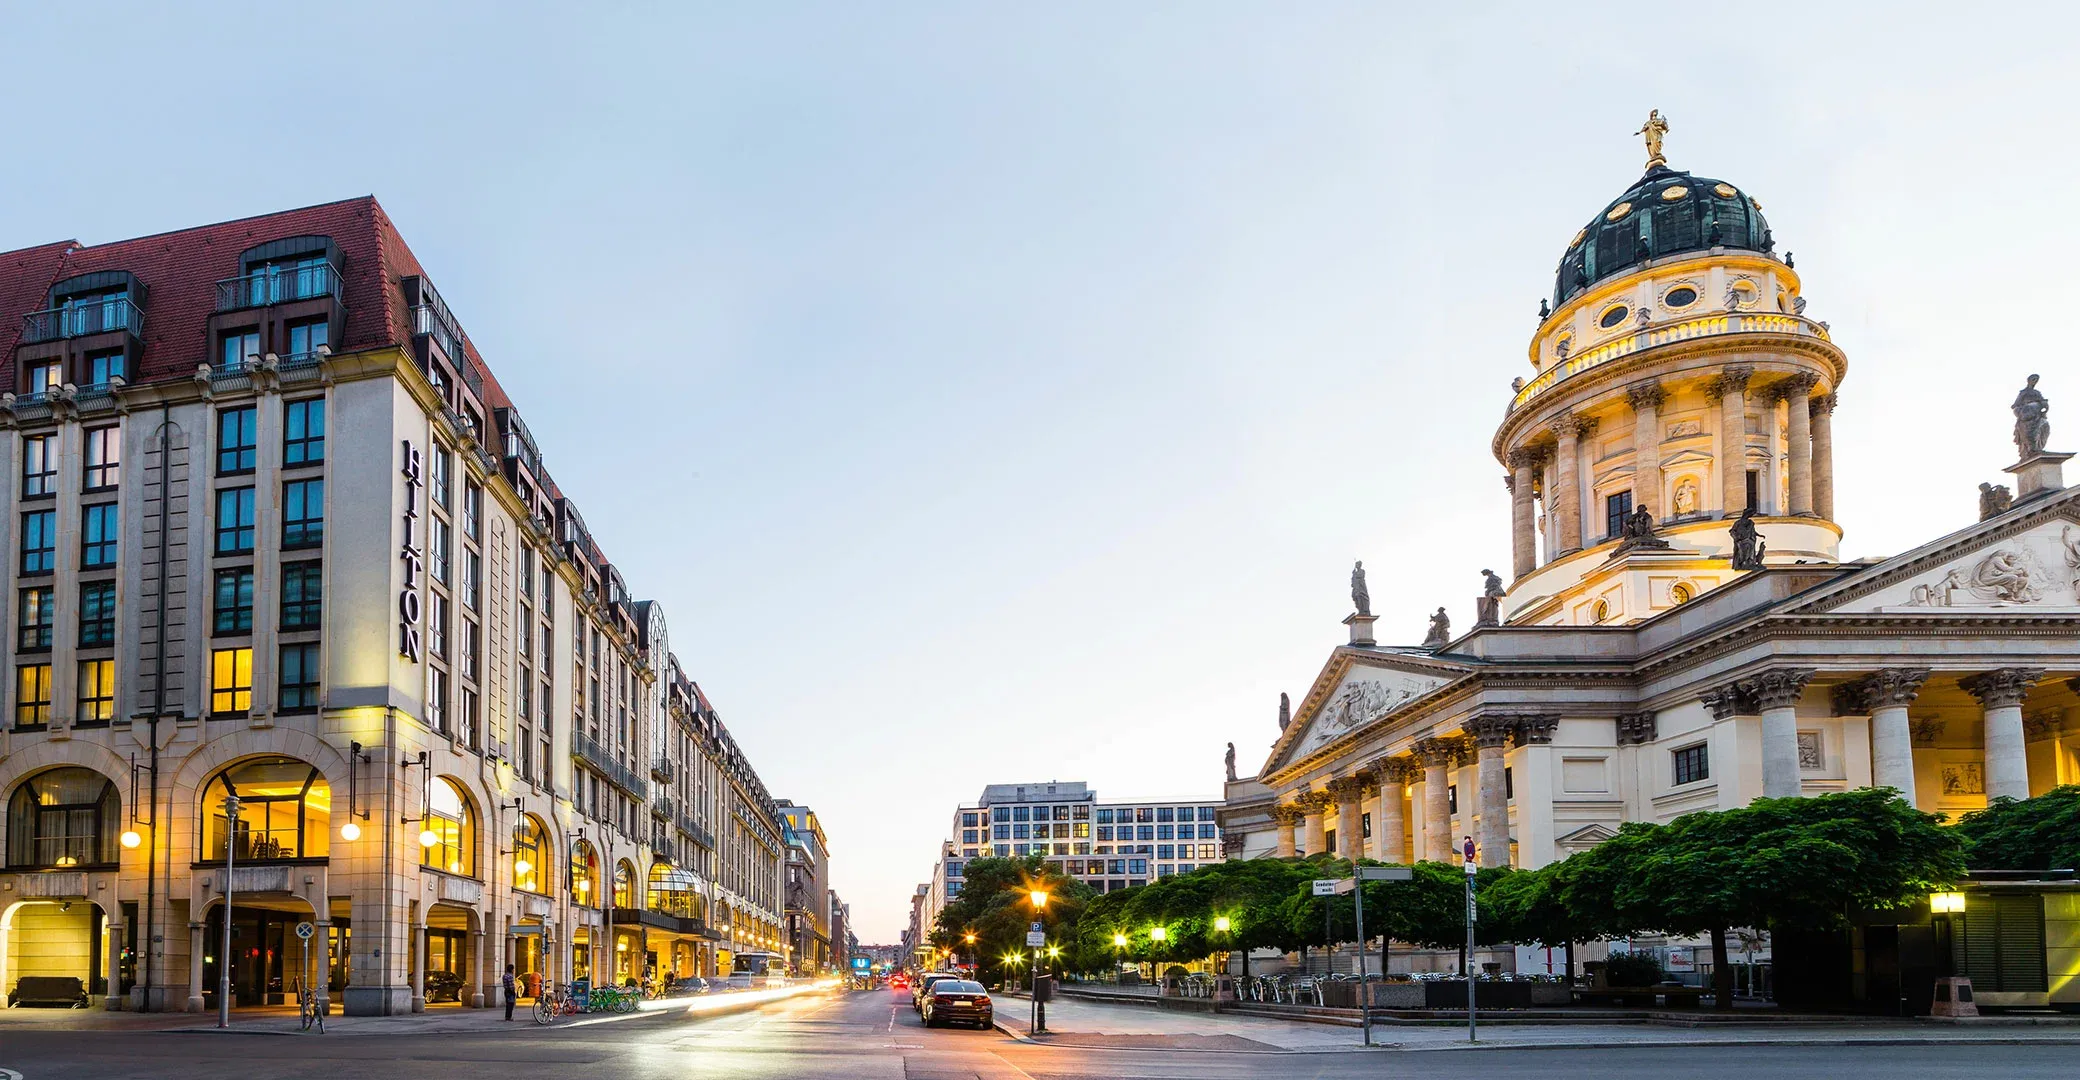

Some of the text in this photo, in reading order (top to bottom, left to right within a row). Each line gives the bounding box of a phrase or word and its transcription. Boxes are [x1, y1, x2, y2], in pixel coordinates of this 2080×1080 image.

[400, 439, 423, 664] HILTON
[1033, 923, 1039, 931] P
[858, 958, 865, 967] U
